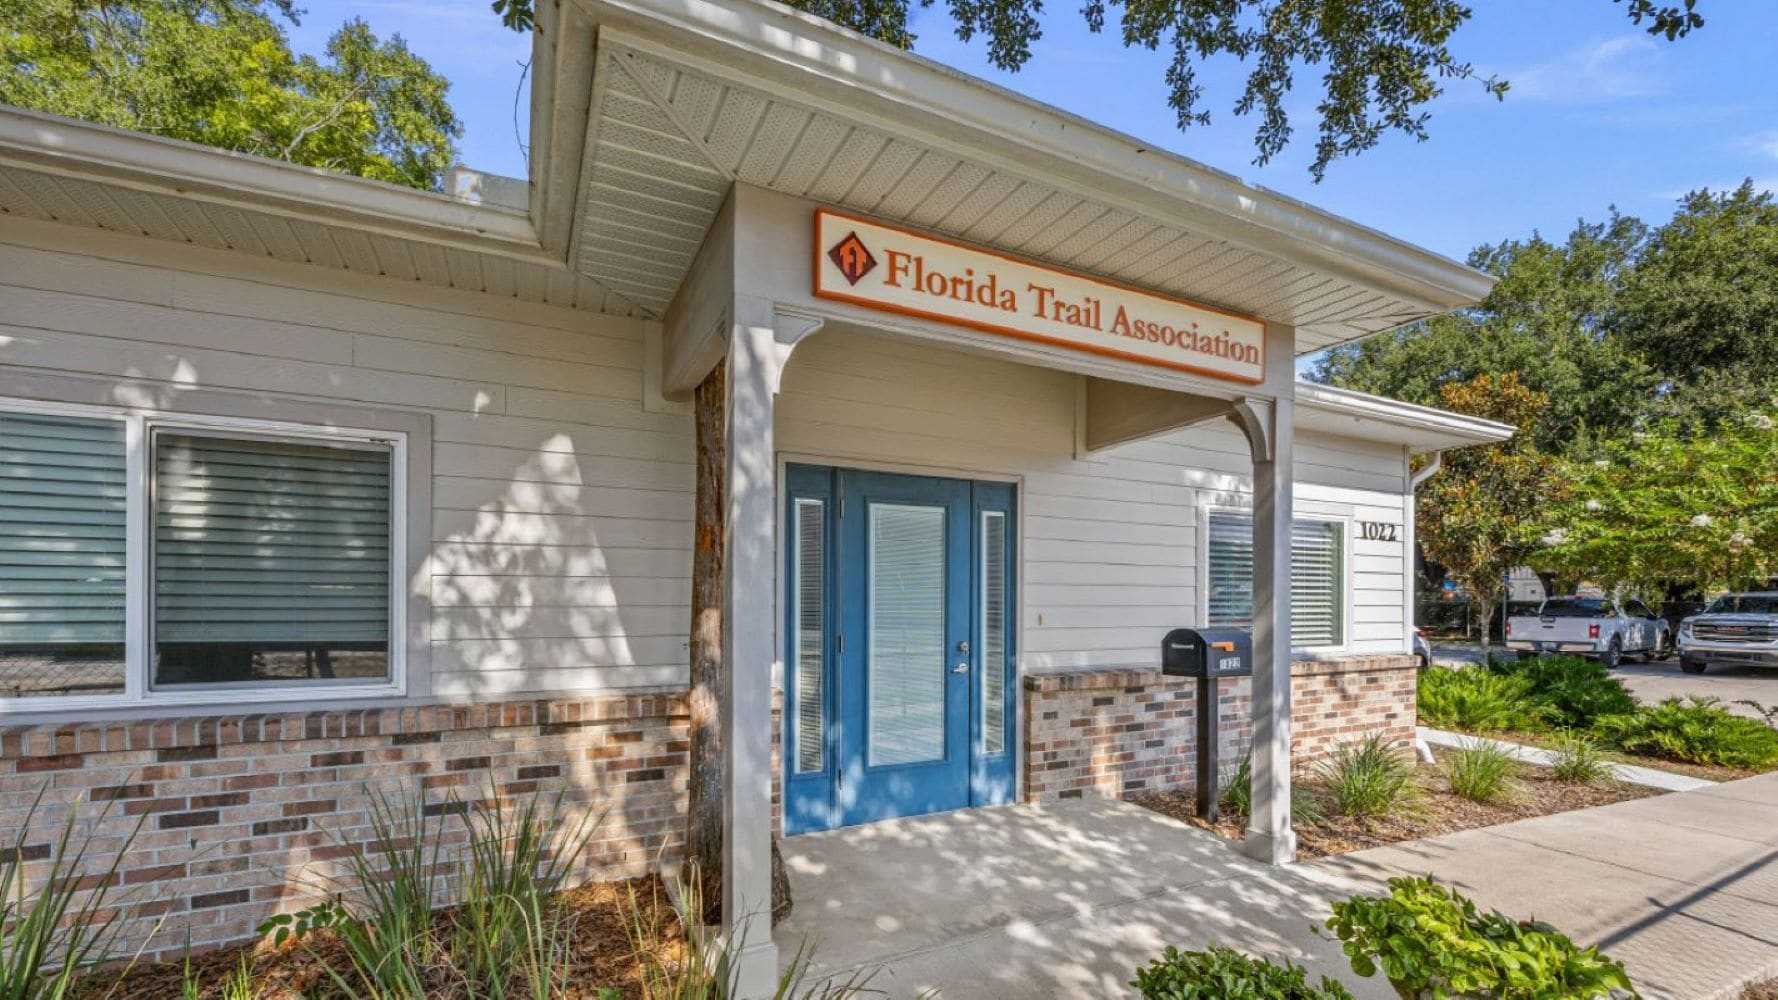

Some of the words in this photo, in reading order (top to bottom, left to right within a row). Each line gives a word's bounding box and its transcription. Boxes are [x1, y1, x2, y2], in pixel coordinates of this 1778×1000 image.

[883, 249, 1018, 313] Florida
[1027, 283, 1103, 331] Trail
[1109, 305, 1260, 366] Association
[1360, 521, 1396, 541] 1022
